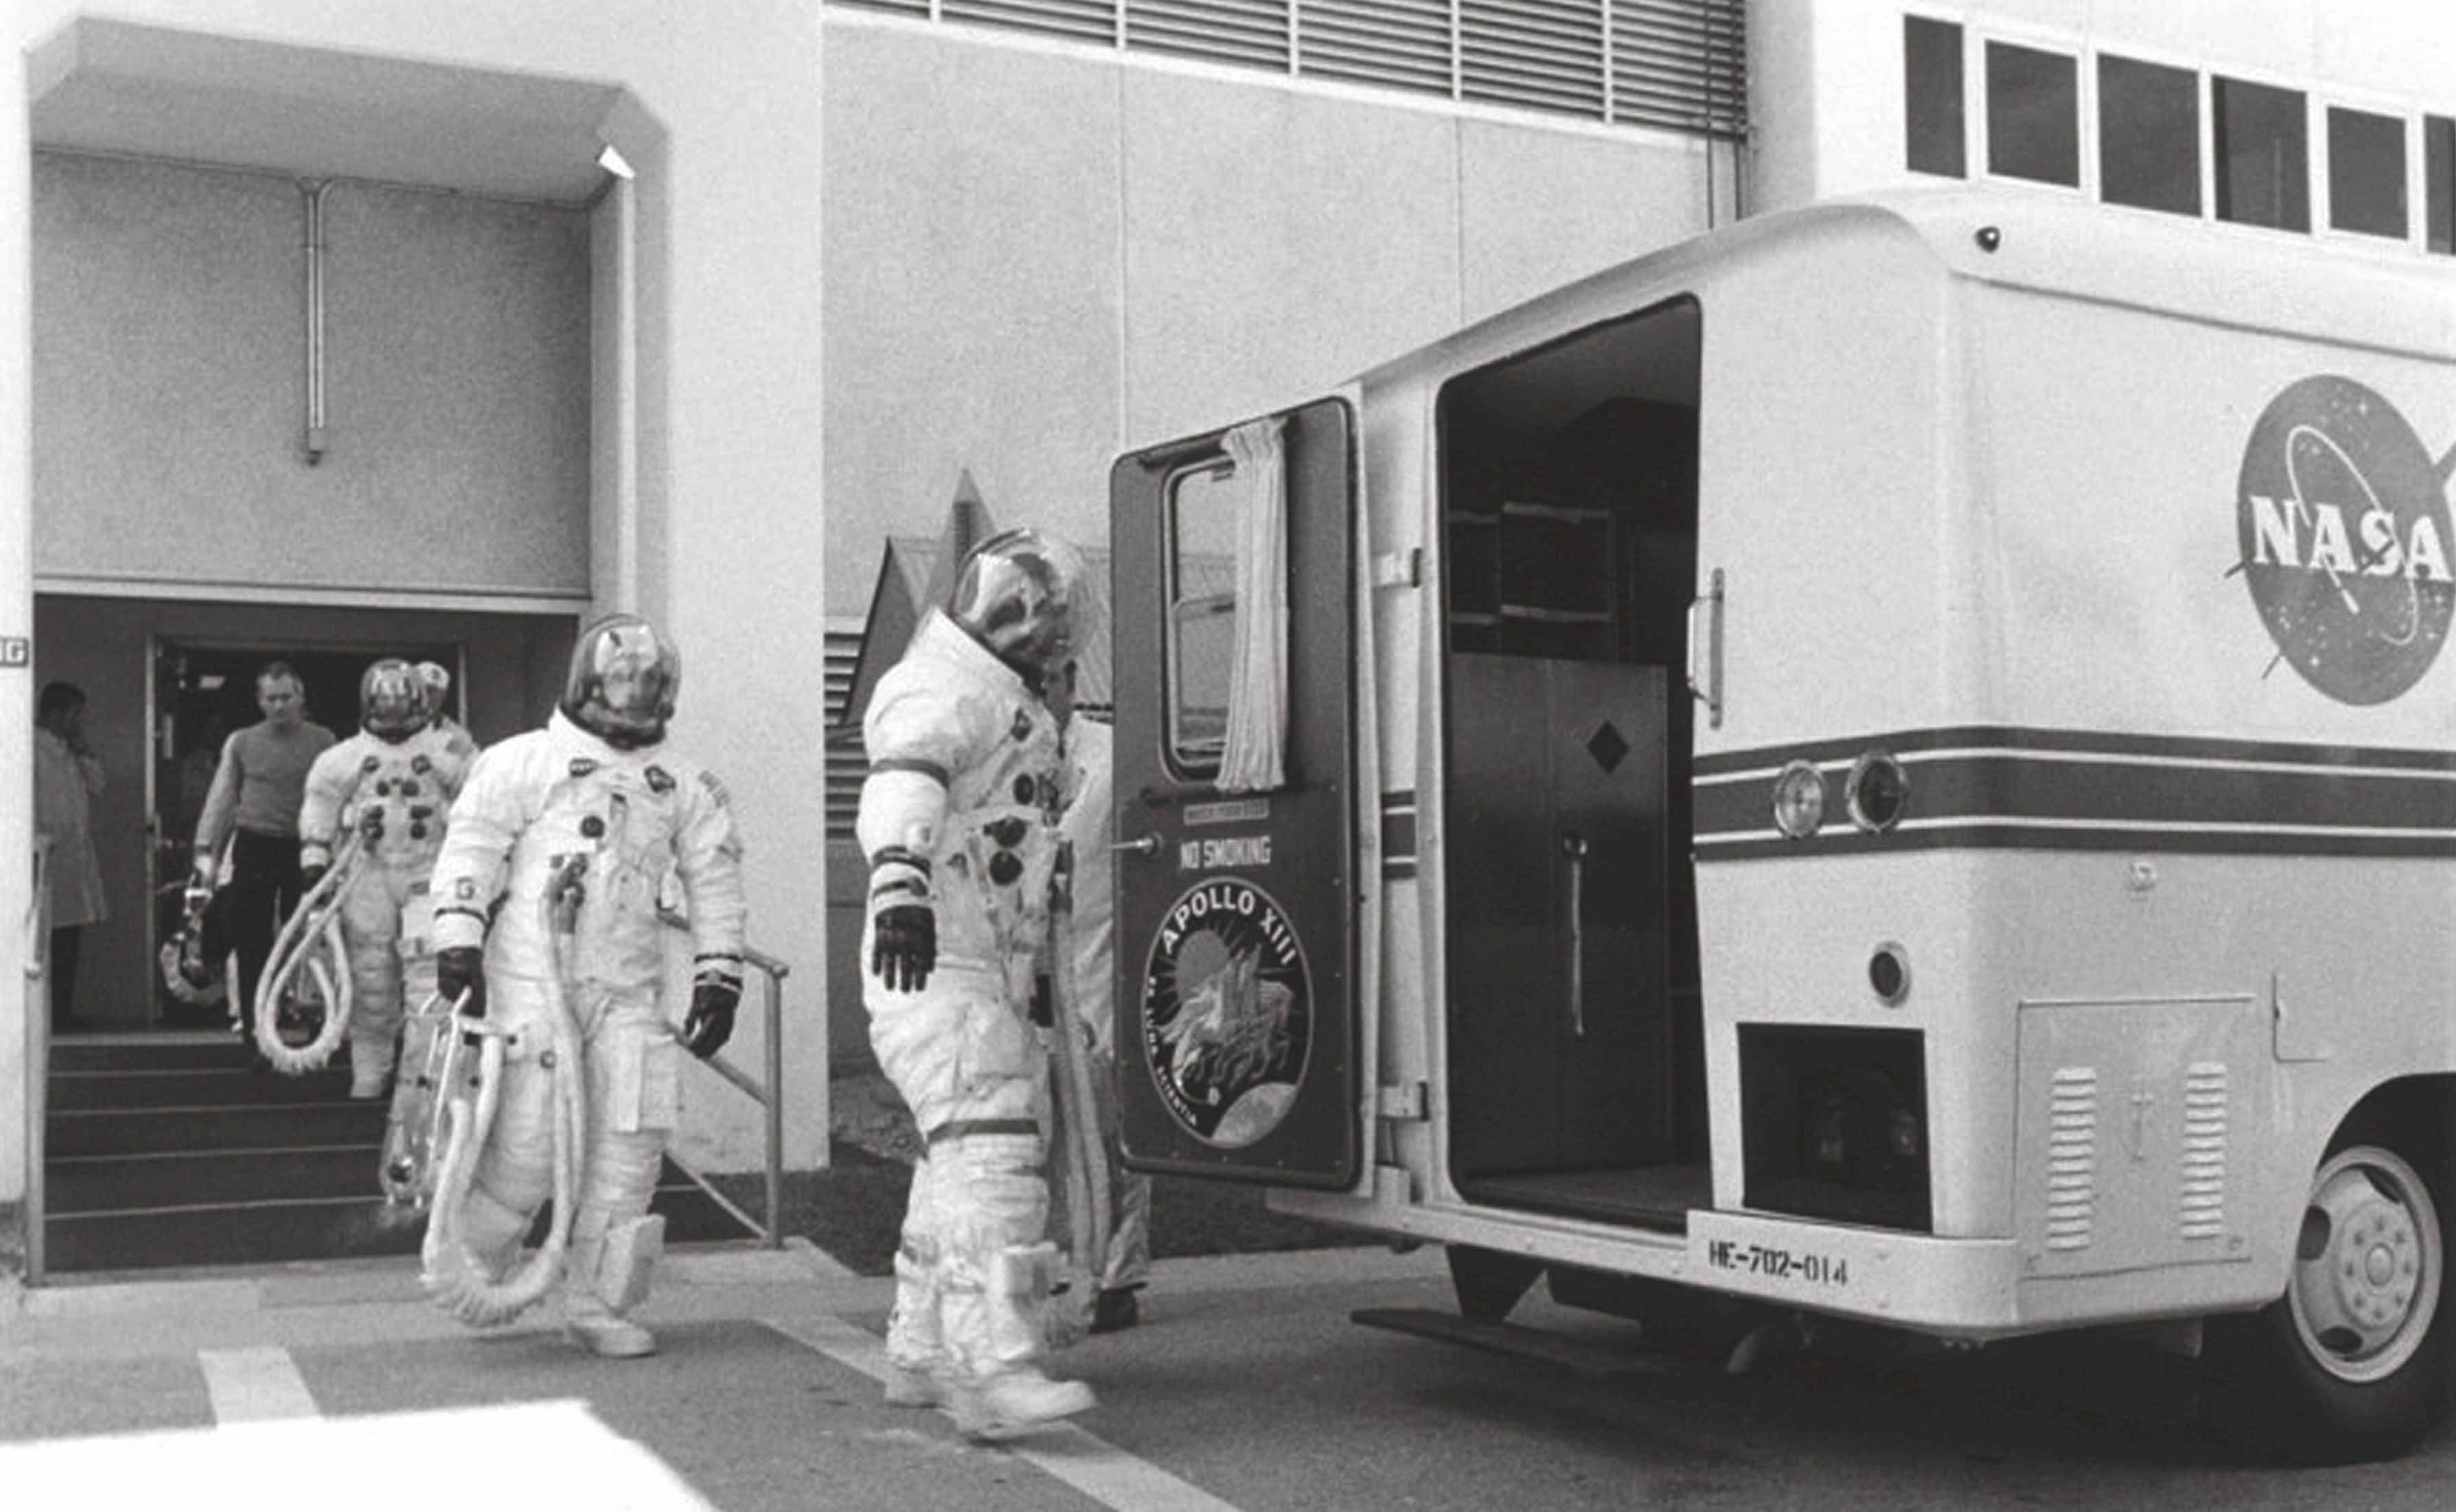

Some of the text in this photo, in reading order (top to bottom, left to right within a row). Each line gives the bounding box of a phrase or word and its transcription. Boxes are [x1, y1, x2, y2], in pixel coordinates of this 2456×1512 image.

[2250, 495, 2454, 583] NASA
[0, 642, 25, 663] G
[1181, 836, 1271, 869] NO SMOKING
[1163, 885, 1297, 965] APOLLO XIII
[1709, 1240, 1848, 1286] HE-702-014
